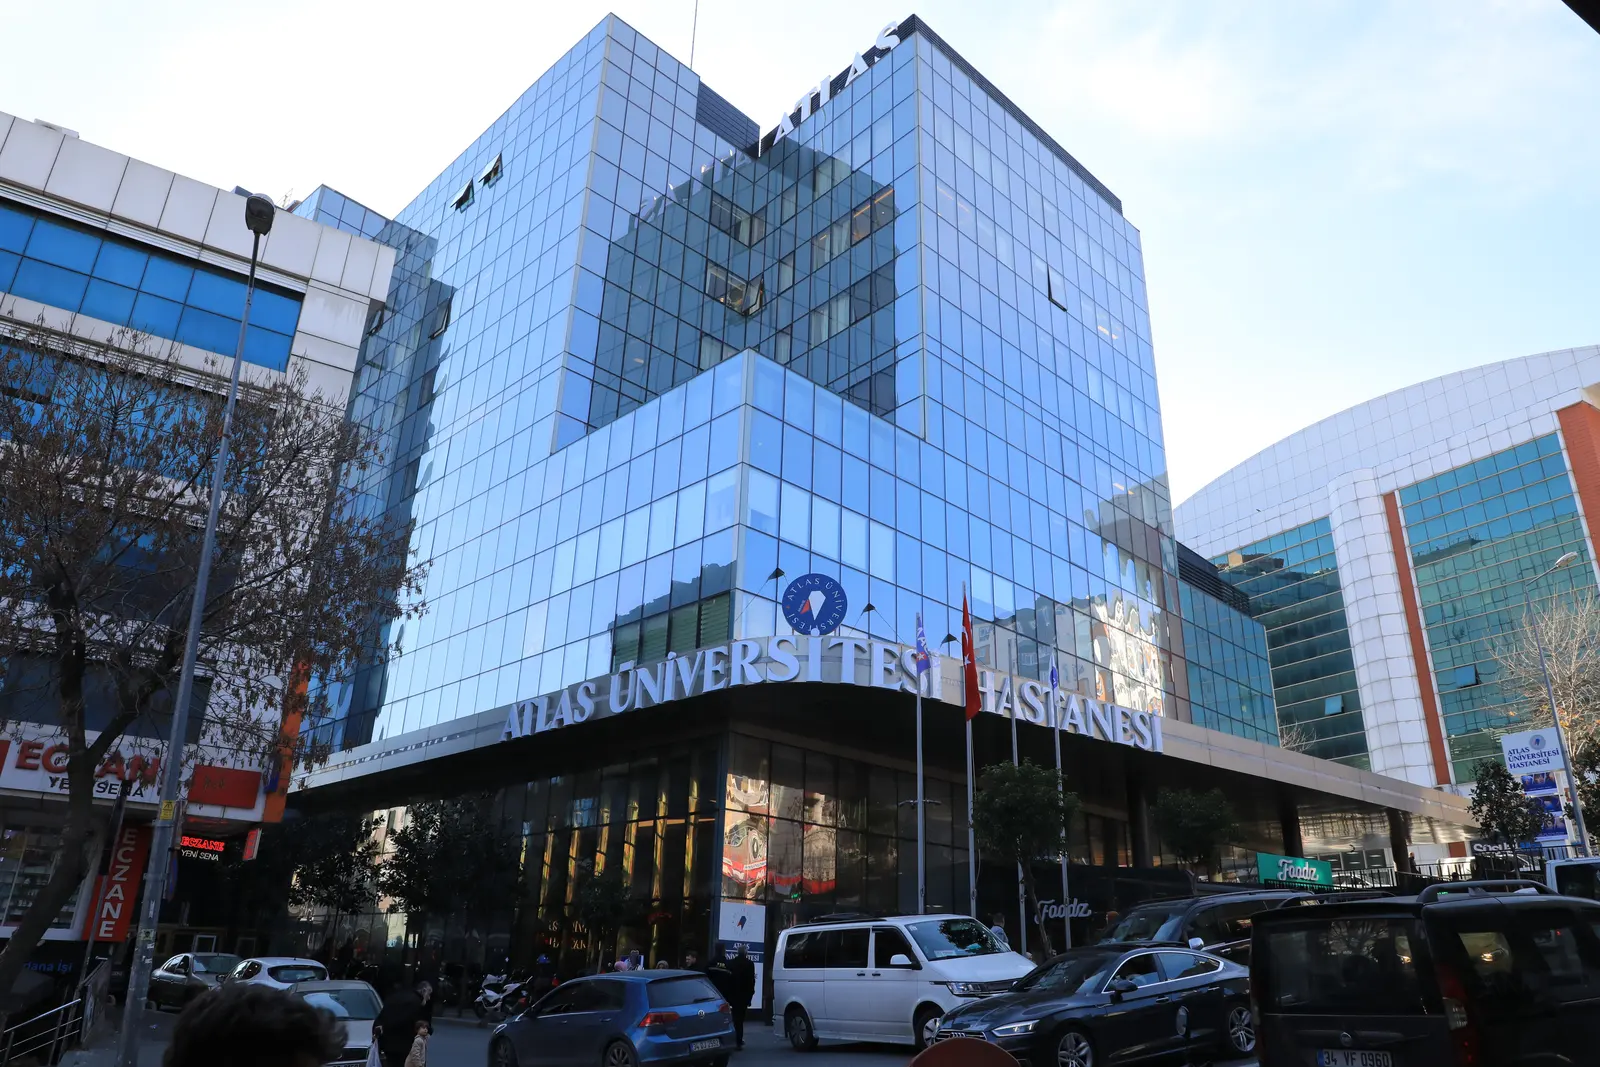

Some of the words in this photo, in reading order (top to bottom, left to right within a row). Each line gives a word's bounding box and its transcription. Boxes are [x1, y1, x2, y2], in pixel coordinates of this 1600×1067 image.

[773, 20, 901, 146] ATLAS
[787, 577, 820, 601] ATLAS
[500, 682, 597, 742] ATLAS
[609, 627, 942, 714] ÜNİVERSİTESİ
[961, 664, 1164, 753] HASTANESİ
[1508, 747, 1530, 756] ATLAS
[1508, 748, 1560, 763] ÜNİVERSİTESİ
[15, 740, 167, 783] ECAN
[1509, 757, 1551, 769] HASTANESİ
[180, 836, 225, 852] ECZANE
[181, 849, 198, 858] YENİ
[199, 852, 219, 861] SENA
[98, 828, 138, 938] ECZANE
[1324, 1051, 1337, 1065] 34
[1344, 1051, 1356, 1066] VF
[1361, 1053, 1389, 1067] 0960
